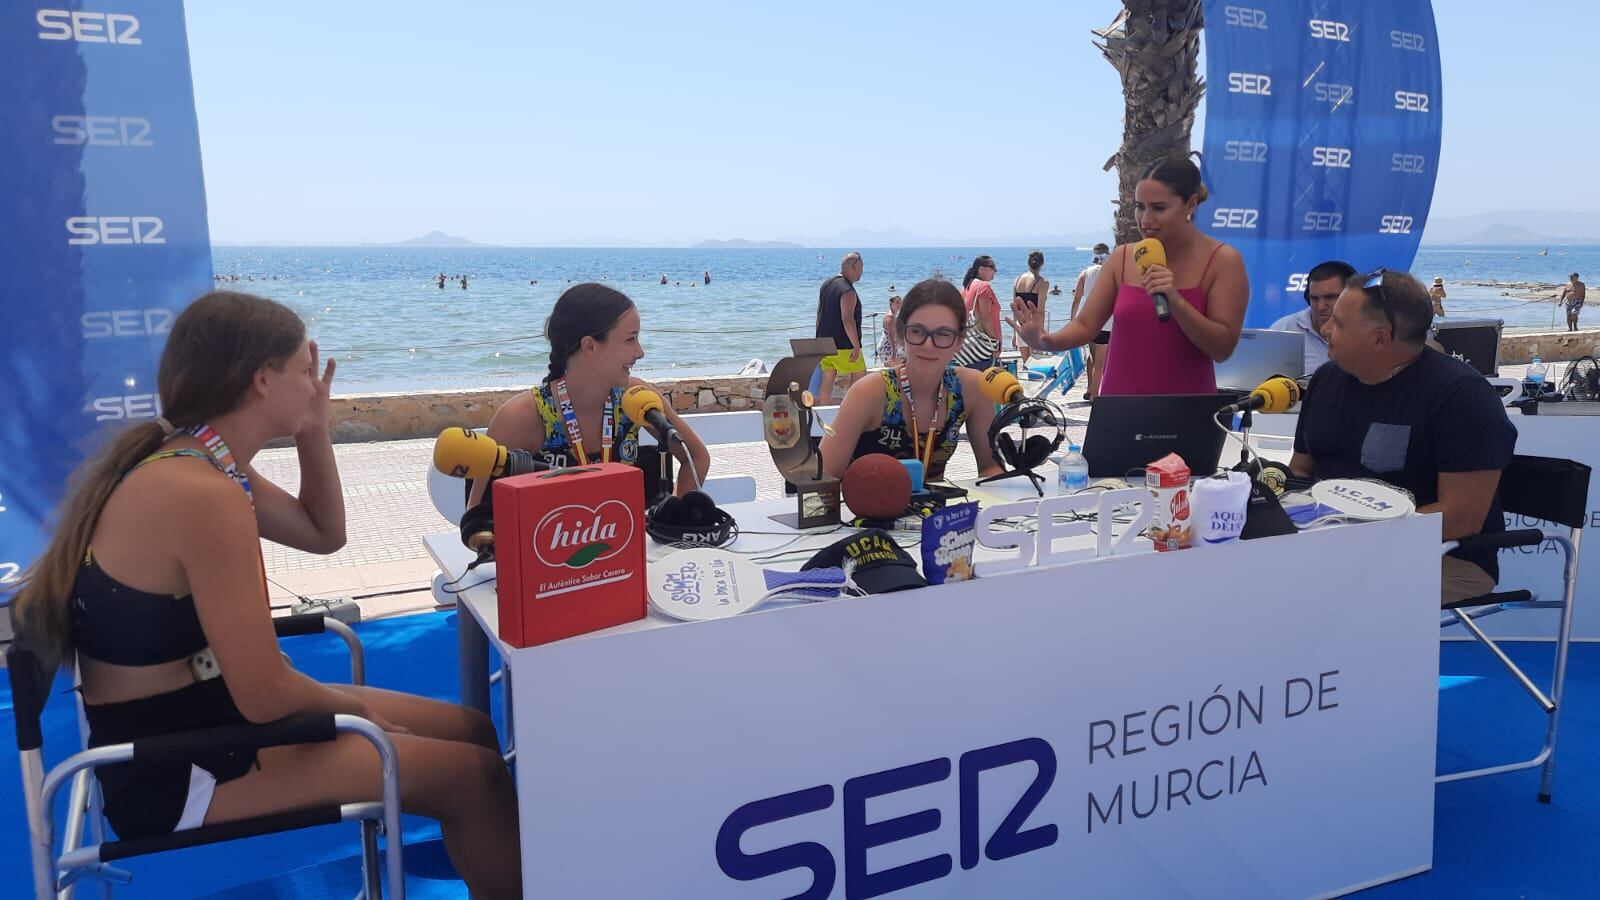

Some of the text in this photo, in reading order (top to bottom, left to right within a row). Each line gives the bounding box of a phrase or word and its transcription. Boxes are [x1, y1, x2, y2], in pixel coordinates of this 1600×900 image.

[36, 9, 142, 45] SER
[1224, 6, 1268, 29] SER
[1309, 19, 1350, 42] SER
[1391, 30, 1425, 51] SER
[1228, 72, 1271, 96] SER
[1315, 82, 1353, 104] SER
[1394, 90, 1429, 112] SER
[51, 115, 154, 147] SER
[1224, 140, 1268, 163] SER
[1312, 146, 1351, 168] SER
[1391, 153, 1425, 173] SER
[1212, 208, 1259, 229] SER
[1302, 211, 1342, 231] SER
[1379, 215, 1413, 234] SER
[66, 216, 166, 245] SER
[1286, 273, 1308, 292] SE
[94, 393, 163, 421] SE
[878, 426, 902, 446] 24
[1334, 485, 1393, 510] UCAM
[549, 515, 618, 550] hida
[682, 530, 721, 542] AKG
[974, 487, 1156, 578] SER
[846, 535, 893, 558] UCAM
[539, 568, 626, 592] El Auténtico Sabor Casero
[1088, 669, 1339, 764] REGIÓN DE
[1087, 750, 1267, 833] MURCIA
[716, 736, 1059, 900] SER
